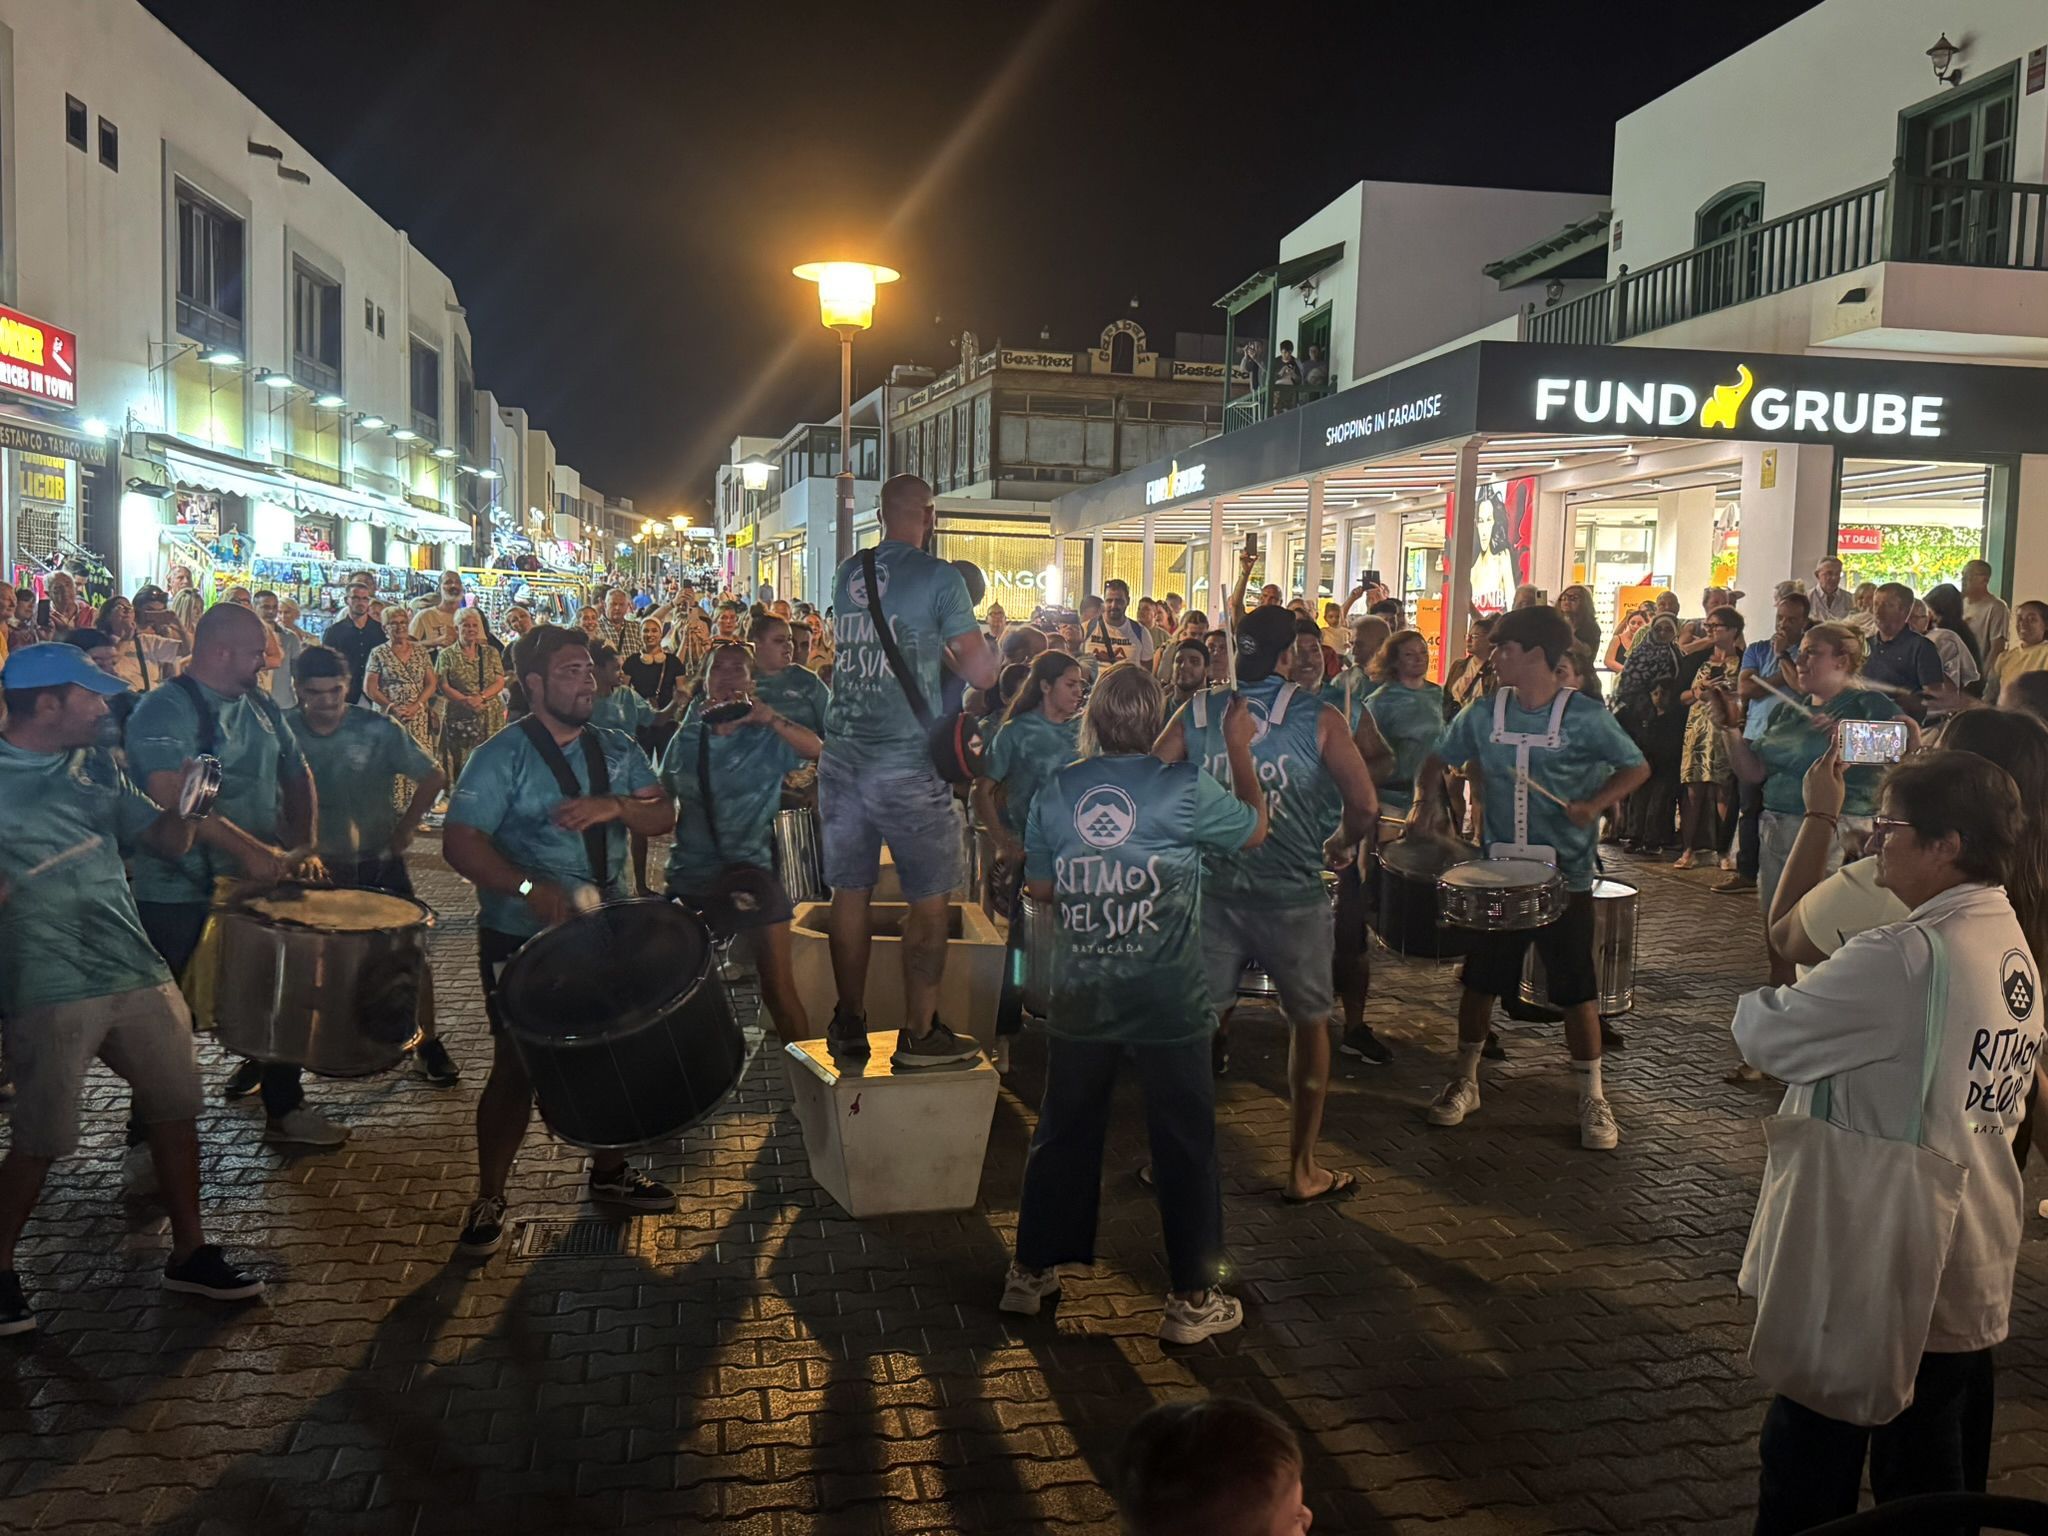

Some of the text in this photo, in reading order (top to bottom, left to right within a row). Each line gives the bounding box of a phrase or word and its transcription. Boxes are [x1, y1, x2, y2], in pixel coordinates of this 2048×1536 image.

[30, 371, 43, 393] IN
[44, 374, 73, 401] TOWN
[1535, 378, 1945, 438] FUND GRUBE
[1326, 414, 1373, 446] SHOPPING
[1374, 412, 1386, 432] IN
[48, 436, 81, 458] TABACO
[19, 470, 65, 501] LICOR
[1852, 535, 1877, 545] DEALS
[1055, 855, 1161, 900] RITMOS
[1061, 897, 1160, 938] DEL SUR
